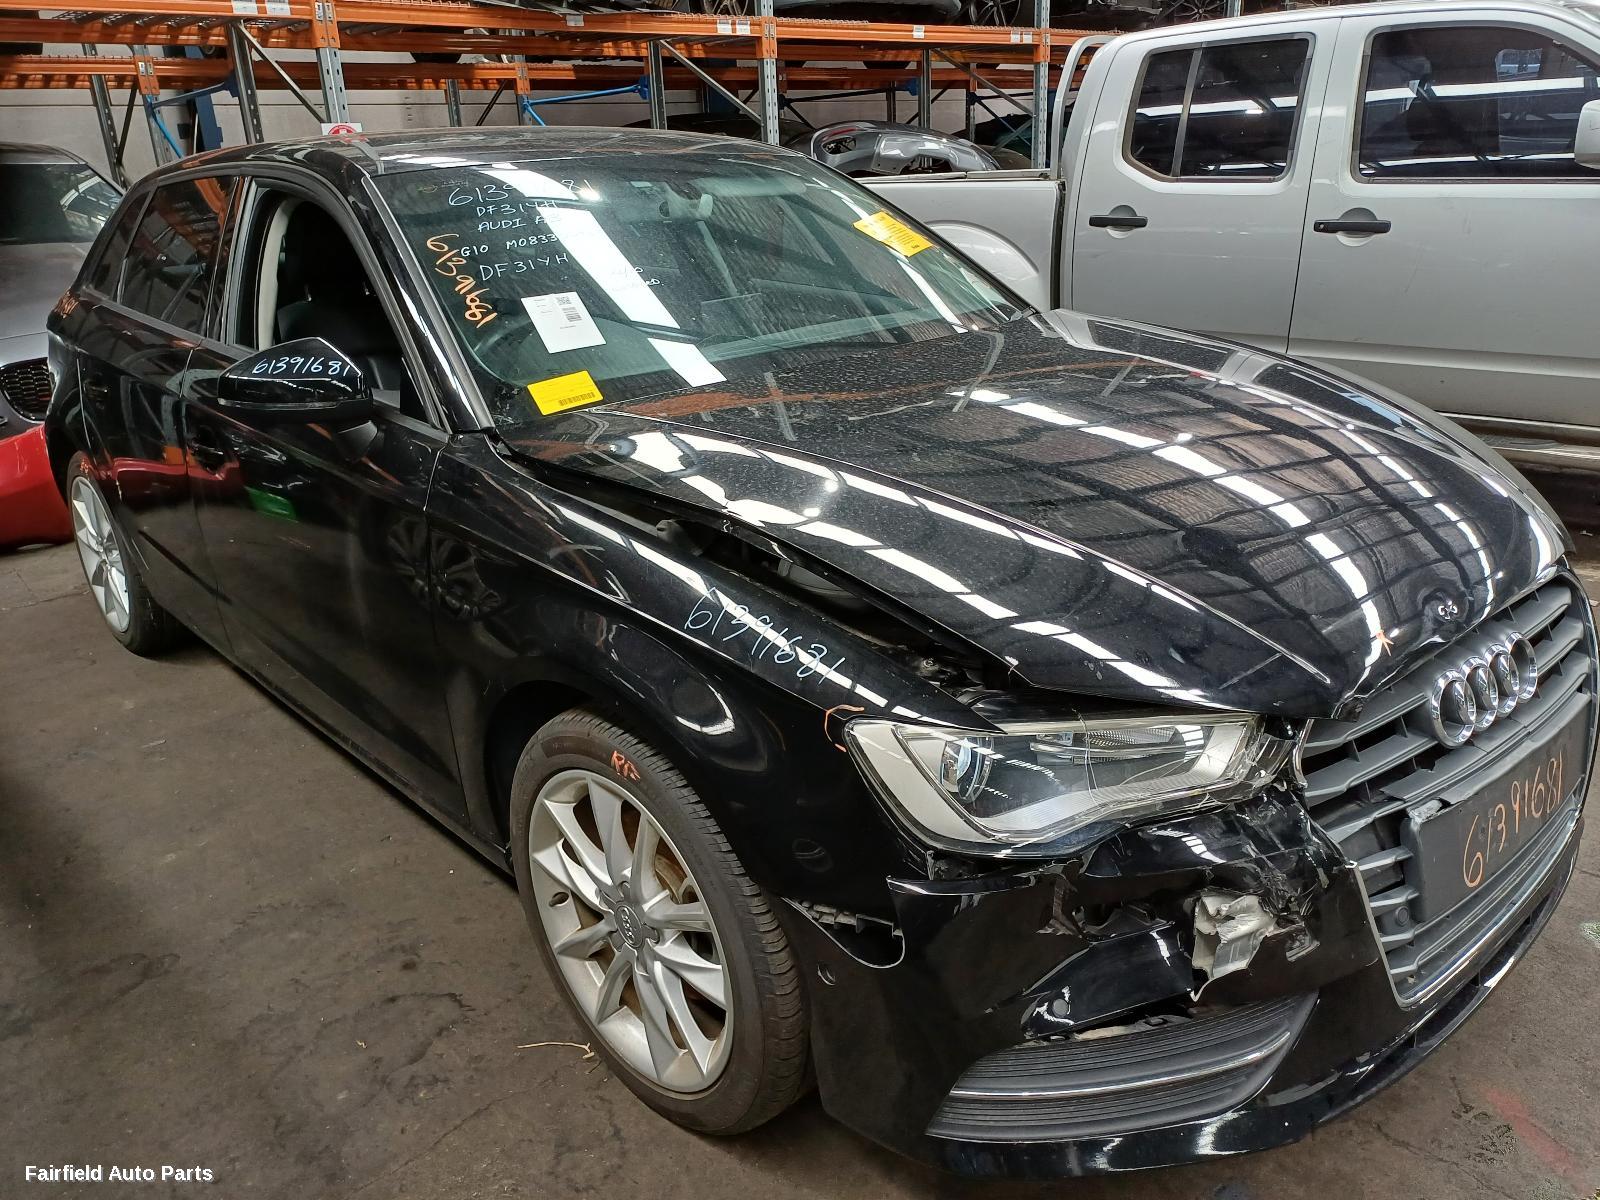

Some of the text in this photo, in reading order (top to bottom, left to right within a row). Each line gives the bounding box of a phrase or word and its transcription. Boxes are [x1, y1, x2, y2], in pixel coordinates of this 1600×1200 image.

[477, 217, 527, 232] AUDI
[460, 244, 489, 257] G10
[479, 252, 569, 281] DF31YH
[251, 356, 351, 377] 61391681
[684, 586, 846, 687] 61391681
[1462, 749, 1563, 888] 61391681
